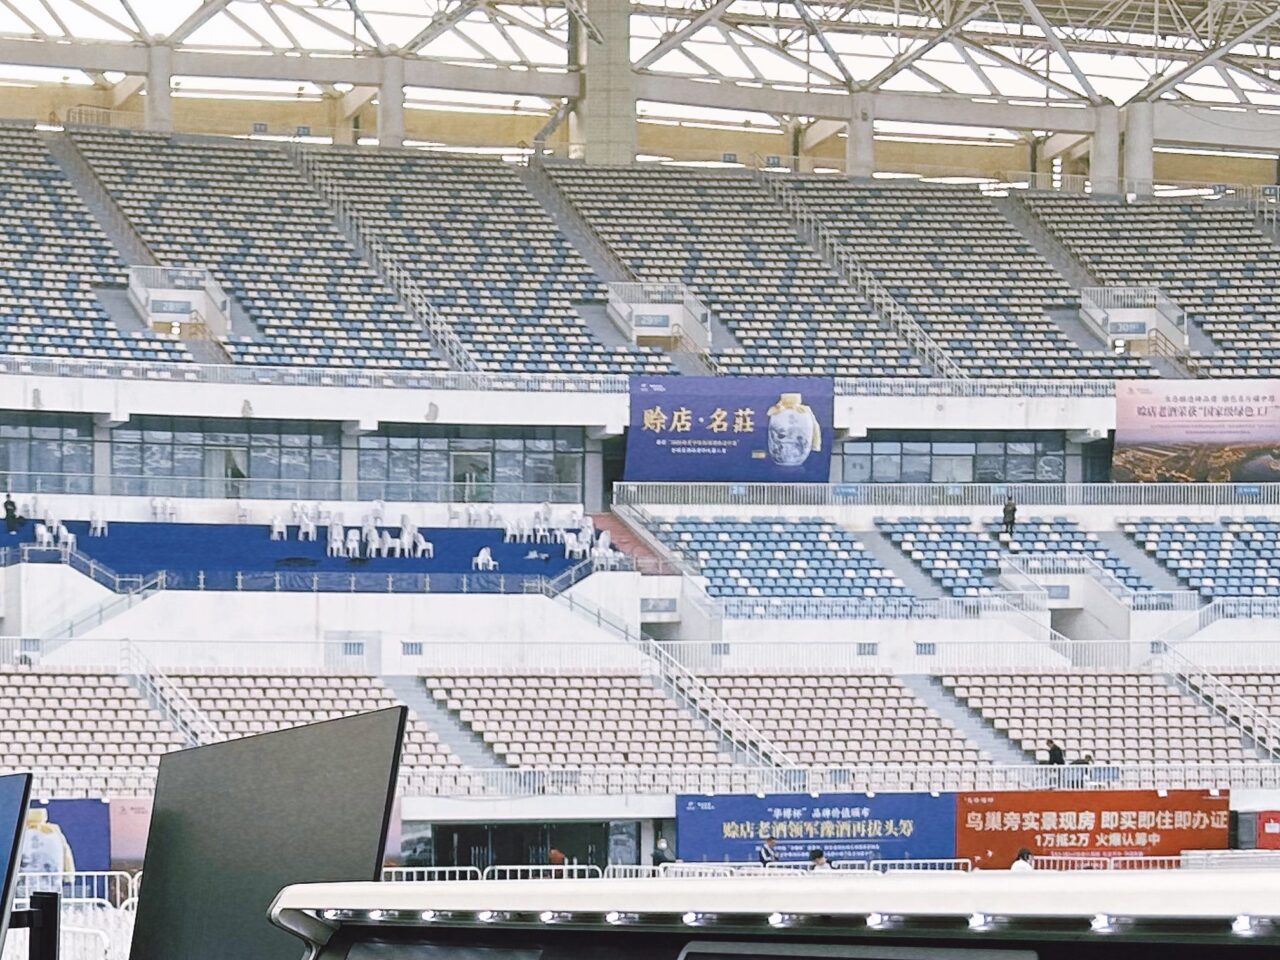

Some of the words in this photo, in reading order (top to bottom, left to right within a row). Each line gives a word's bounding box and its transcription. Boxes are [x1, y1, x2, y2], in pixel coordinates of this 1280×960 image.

[965, 811, 1096, 831] 鸟巢旁实景现房
[1100, 810, 1229, 830] 即买即住即办证
